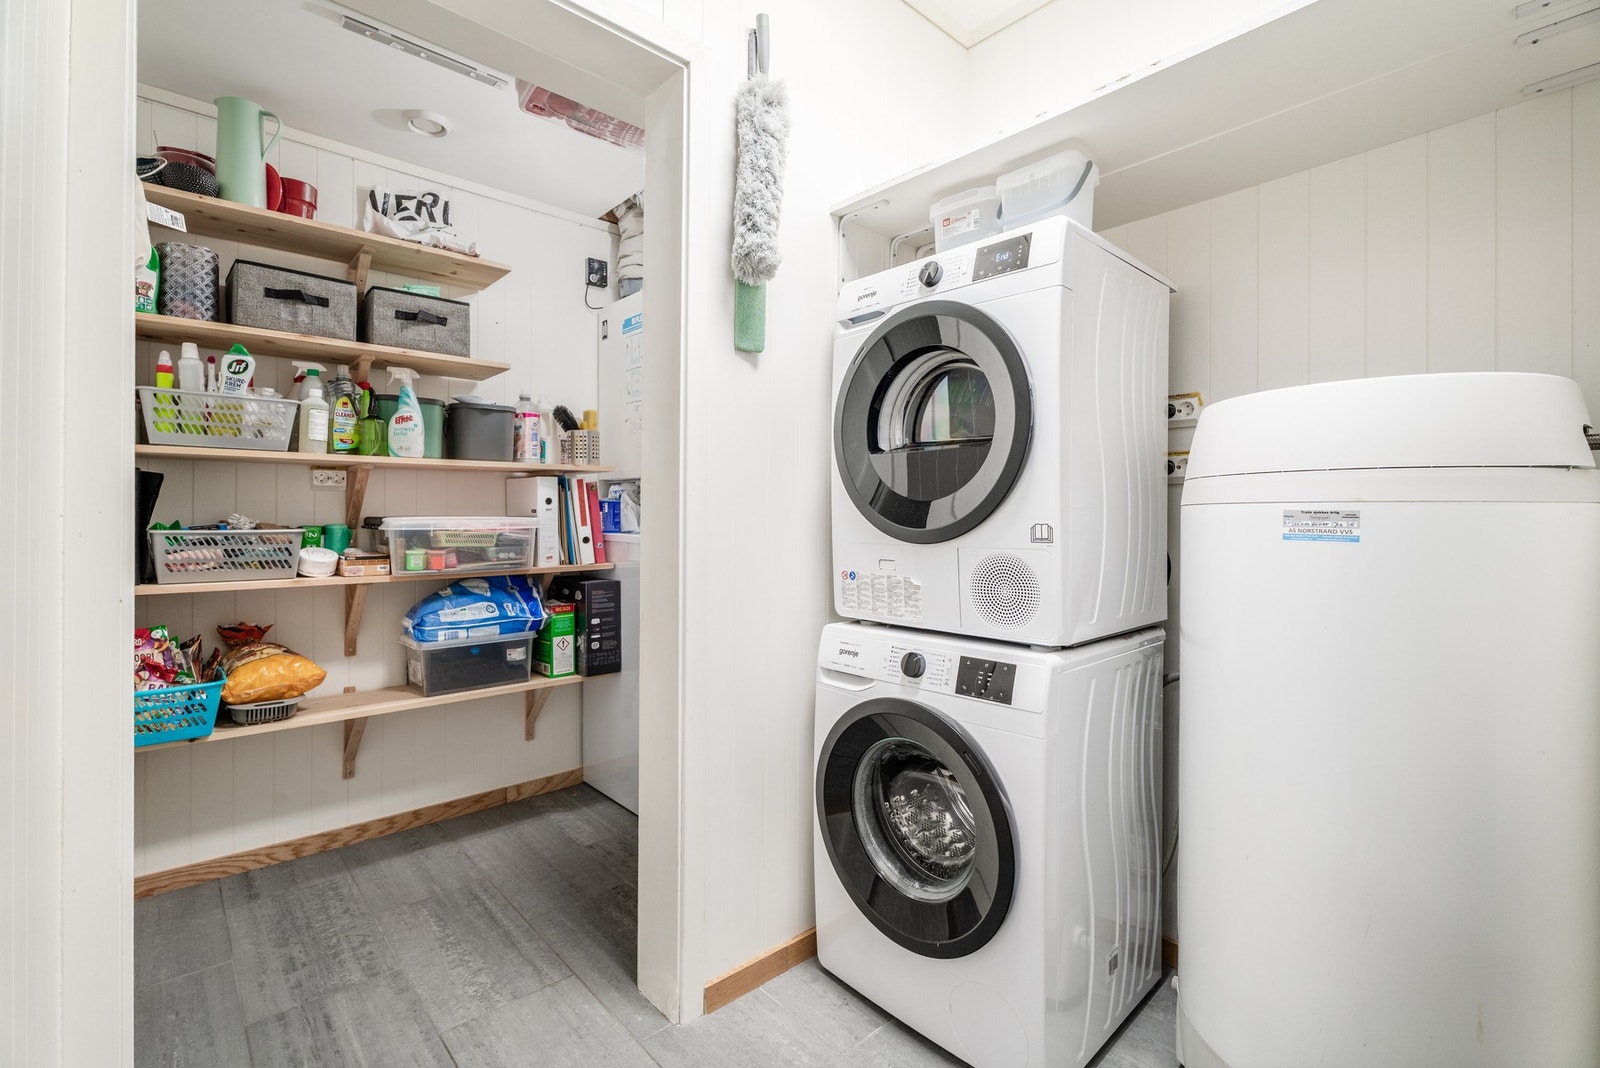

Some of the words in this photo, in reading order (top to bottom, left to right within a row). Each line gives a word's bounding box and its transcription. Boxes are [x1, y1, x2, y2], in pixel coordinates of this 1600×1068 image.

[995, 251, 1010, 263] End
[857, 290, 878, 303] gorenje
[228, 359, 247, 373] Jif
[224, 381, 242, 389] KREM
[395, 414, 414, 425] Effekt
[838, 648, 859, 658] gorenje
